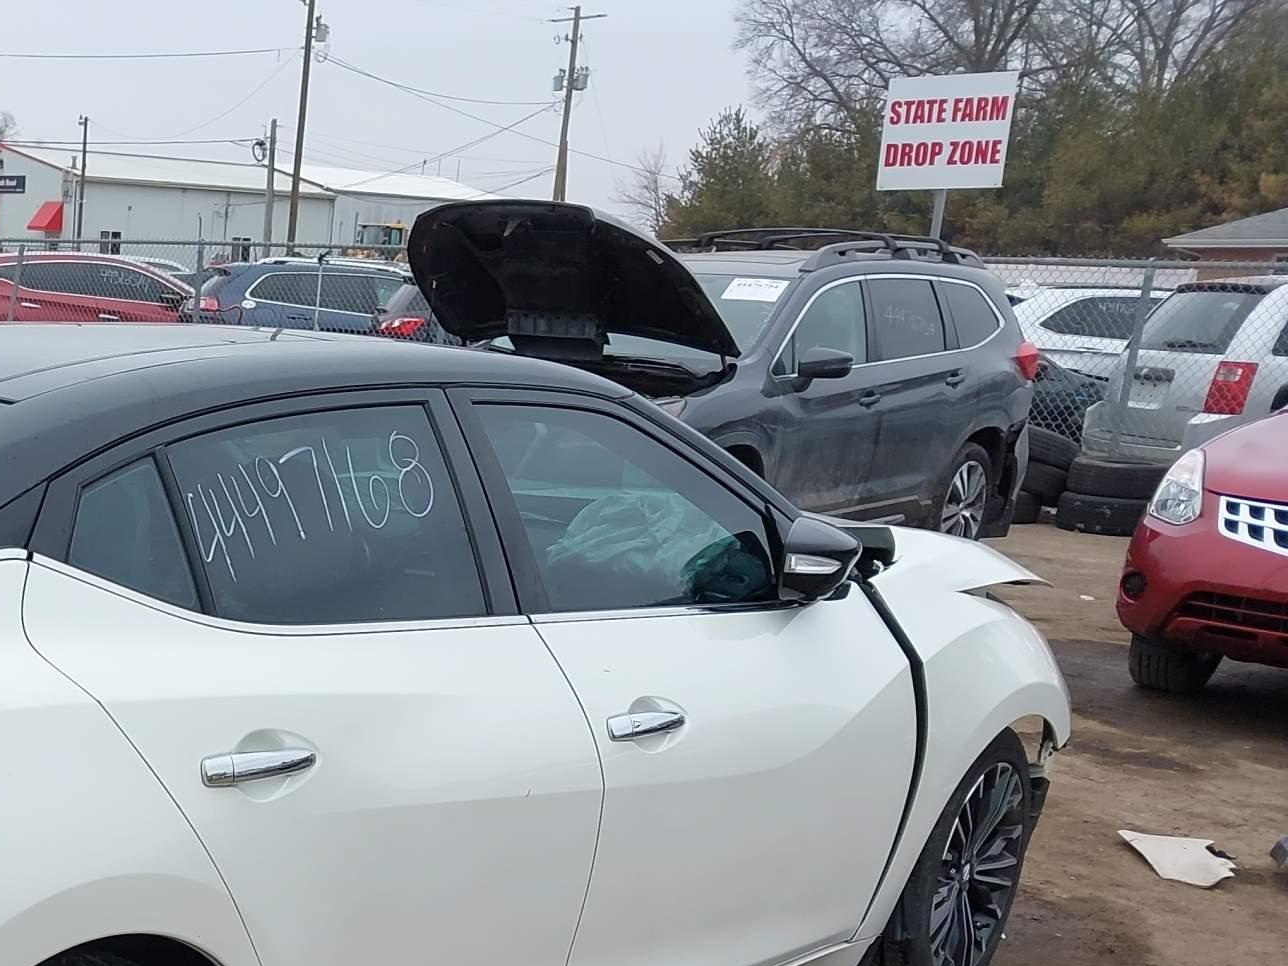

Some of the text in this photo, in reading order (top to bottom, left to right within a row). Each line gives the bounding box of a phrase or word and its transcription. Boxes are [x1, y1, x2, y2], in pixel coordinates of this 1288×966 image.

[889, 95, 1010, 126] STATE FARM
[883, 139, 1003, 168] DROP ZONE
[187, 430, 435, 585] 44497168
